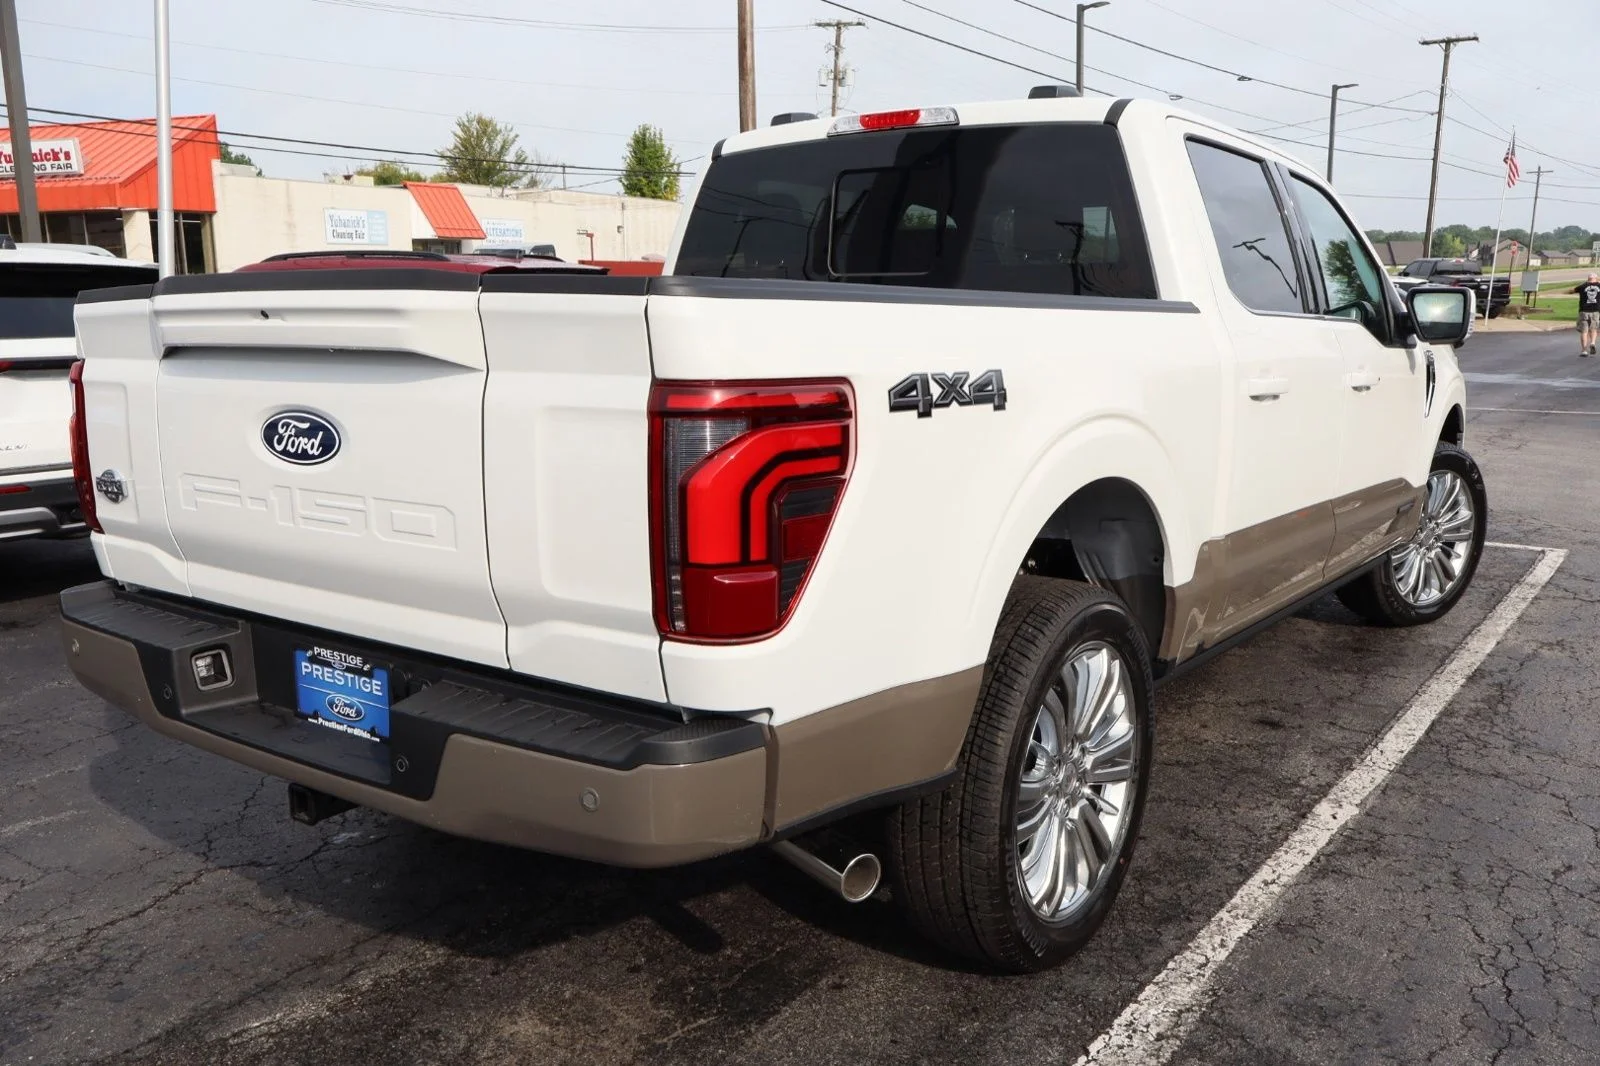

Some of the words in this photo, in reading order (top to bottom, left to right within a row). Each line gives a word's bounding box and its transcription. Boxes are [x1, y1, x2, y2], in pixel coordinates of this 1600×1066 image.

[0, 148, 71, 164] unick's
[0, 164, 47, 173] CLENG
[51, 163, 73, 171] FAIR
[332, 229, 353, 240] Cleaning
[355, 230, 365, 239] Fair
[274, 418, 323, 456] Ford
[178, 472, 456, 551] F-150
[313, 646, 363, 666] PRESTIGE
[301, 662, 383, 695] PRESTIGE
[333, 697, 357, 717] Ford
